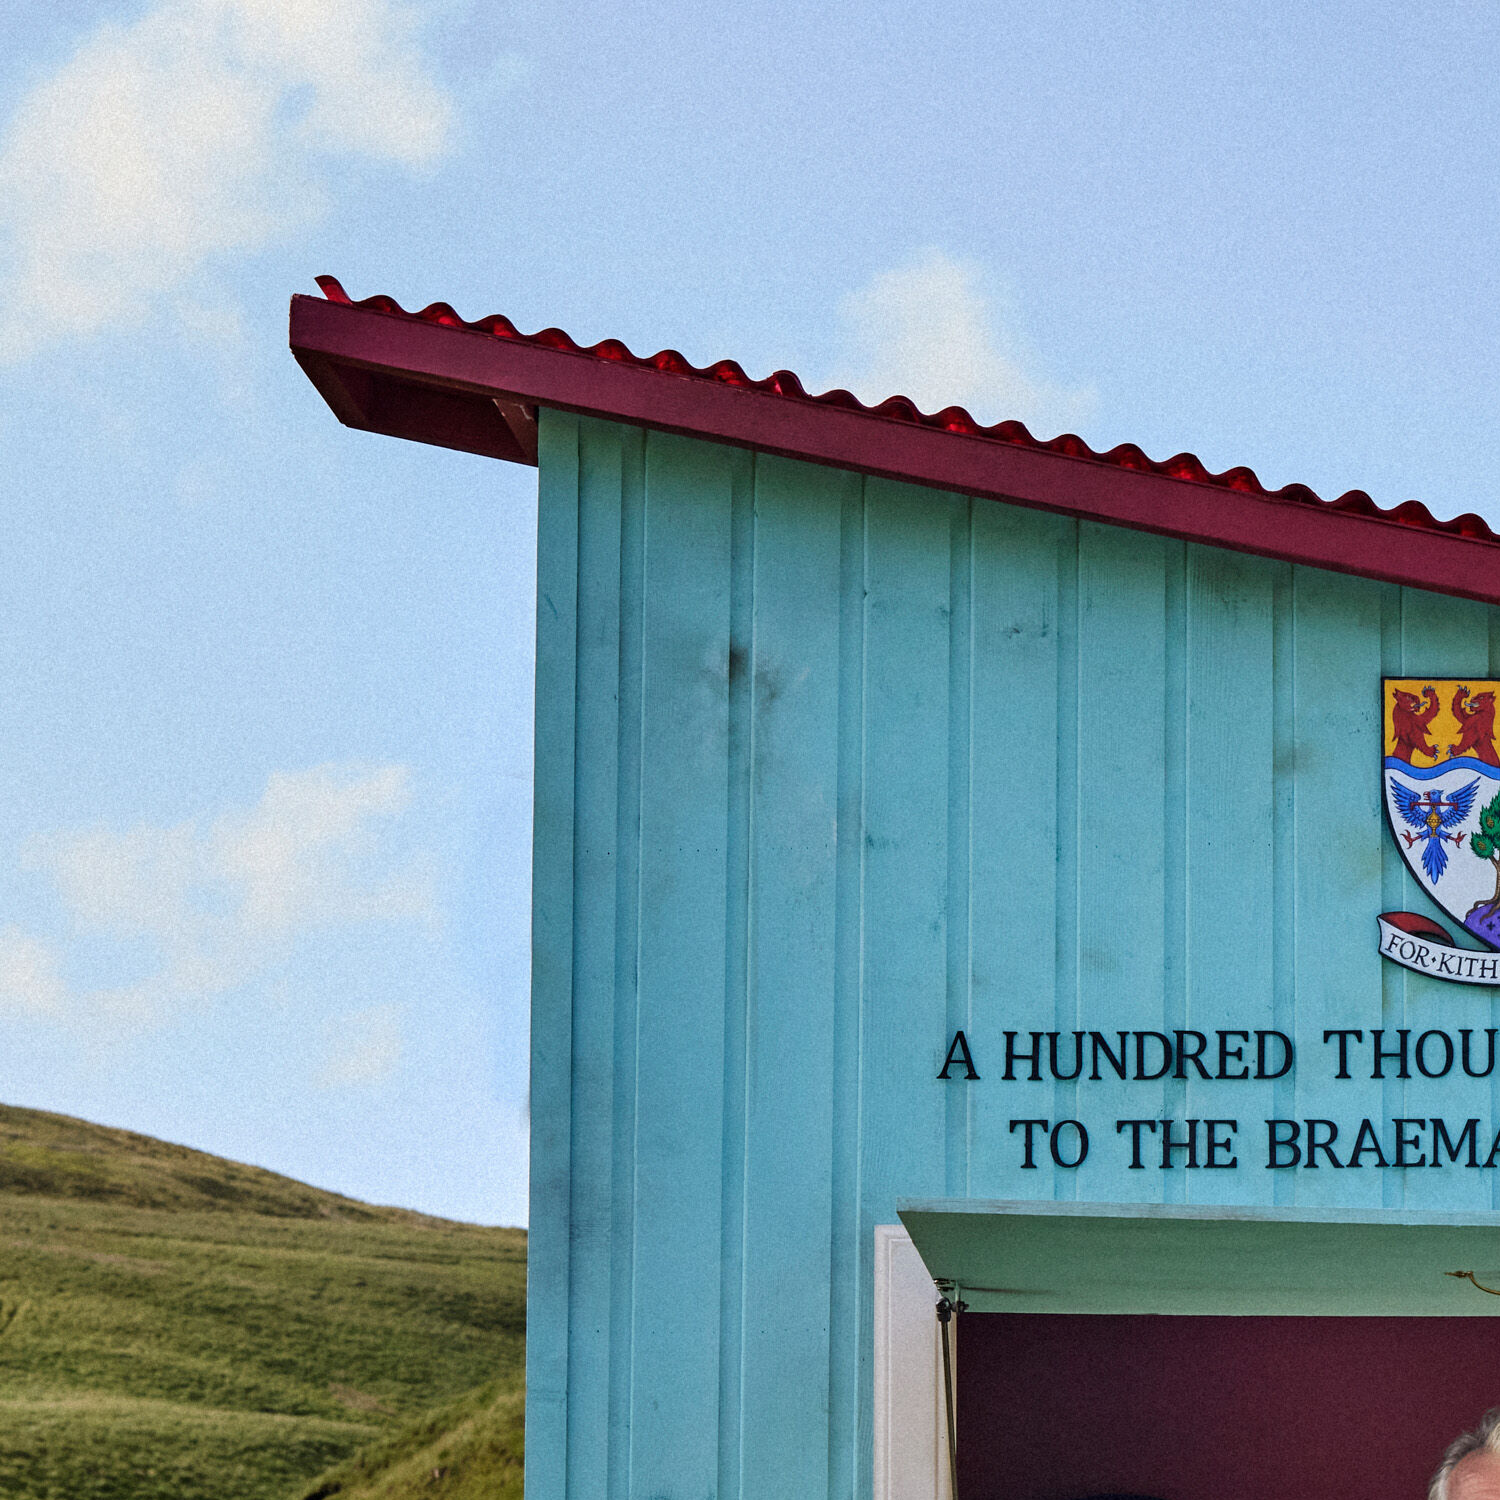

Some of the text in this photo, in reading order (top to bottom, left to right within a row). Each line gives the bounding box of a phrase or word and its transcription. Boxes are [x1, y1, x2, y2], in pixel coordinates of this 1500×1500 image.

[937, 1031, 980, 1080] A
[1002, 1030, 1295, 1081] HUNDRED
[1009, 1119, 1089, 1169] TO
[1116, 1119, 1238, 1169] THE
